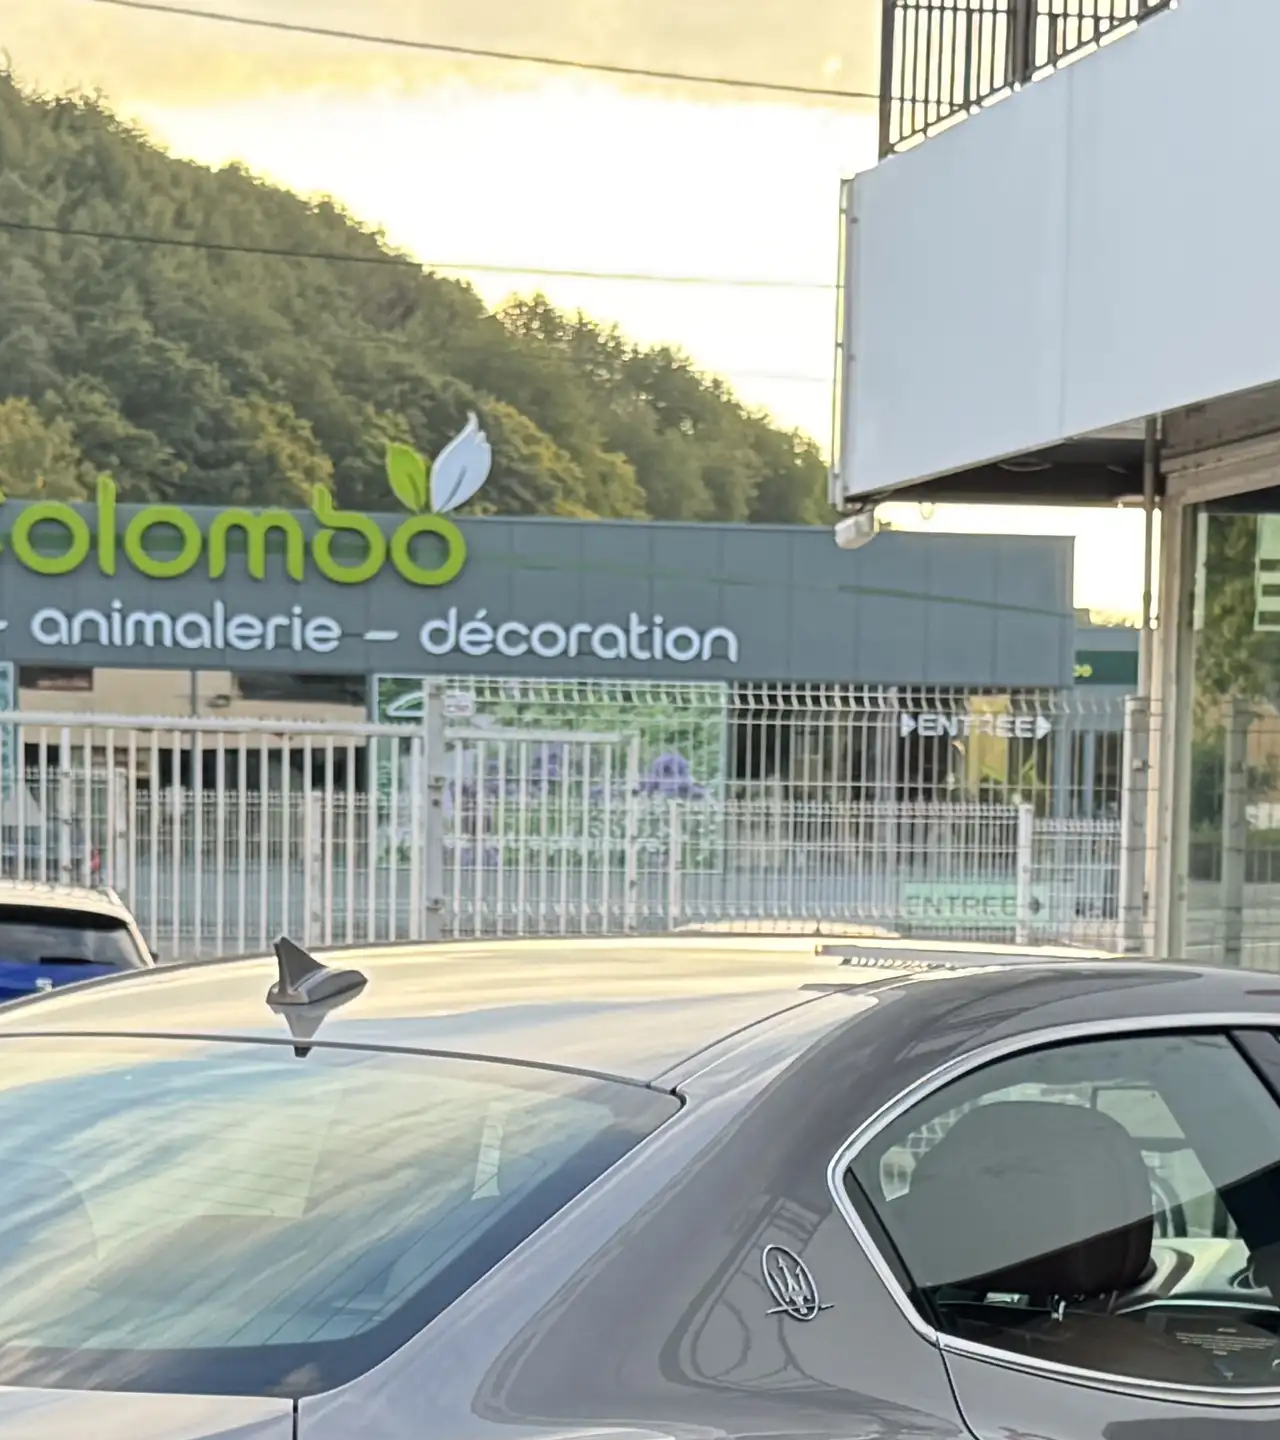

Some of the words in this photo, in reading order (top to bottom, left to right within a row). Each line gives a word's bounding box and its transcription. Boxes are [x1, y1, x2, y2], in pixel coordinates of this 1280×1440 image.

[31, 600, 342, 652] animalerie
[420, 606, 739, 662] décoration
[917, 713, 1035, 738] ENTREE
